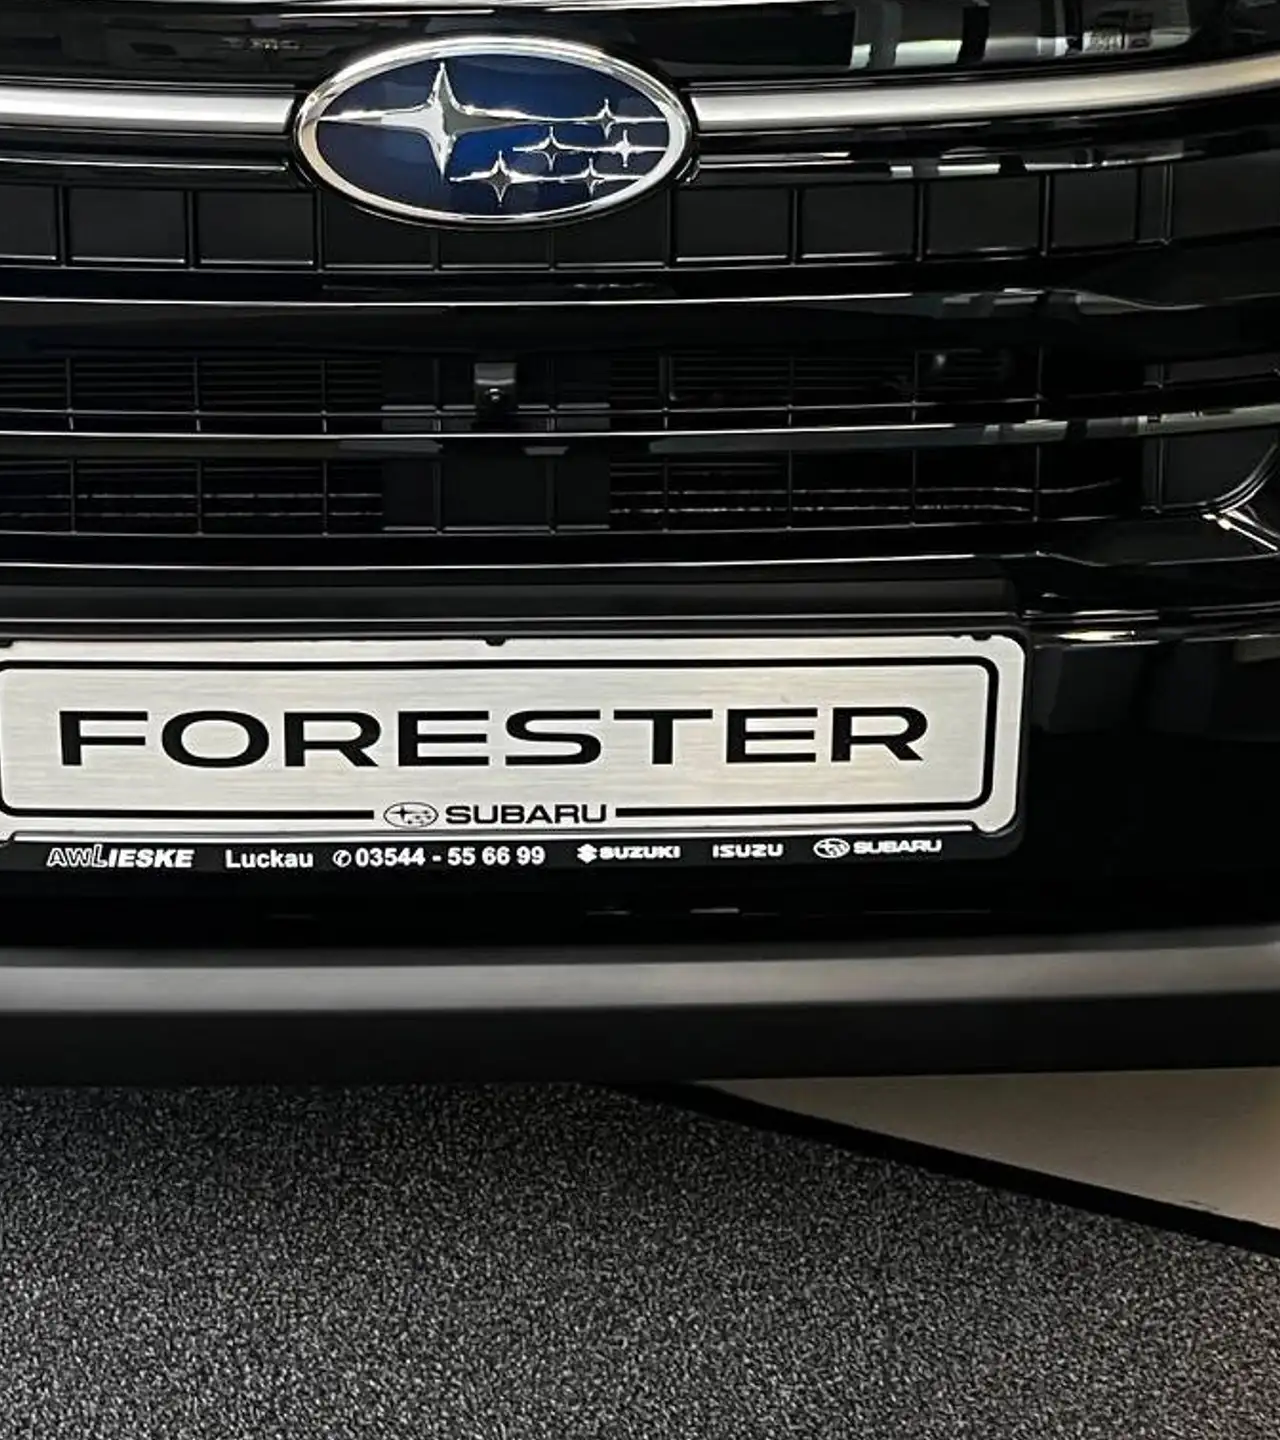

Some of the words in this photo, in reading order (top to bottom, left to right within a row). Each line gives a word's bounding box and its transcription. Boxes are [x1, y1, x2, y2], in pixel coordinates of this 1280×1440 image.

[59, 707, 930, 767] FORESTER
[445, 804, 607, 824] SUBARU
[225, 849, 313, 868] Luckau
[354, 847, 425, 867] 03544
[447, 846, 475, 866] 55
[481, 846, 510, 866] 66
[516, 845, 546, 865] 99
[599, 845, 681, 860] SUZUKI
[712, 843, 784, 858] ISUZU
[853, 839, 942, 855] SUBARU
